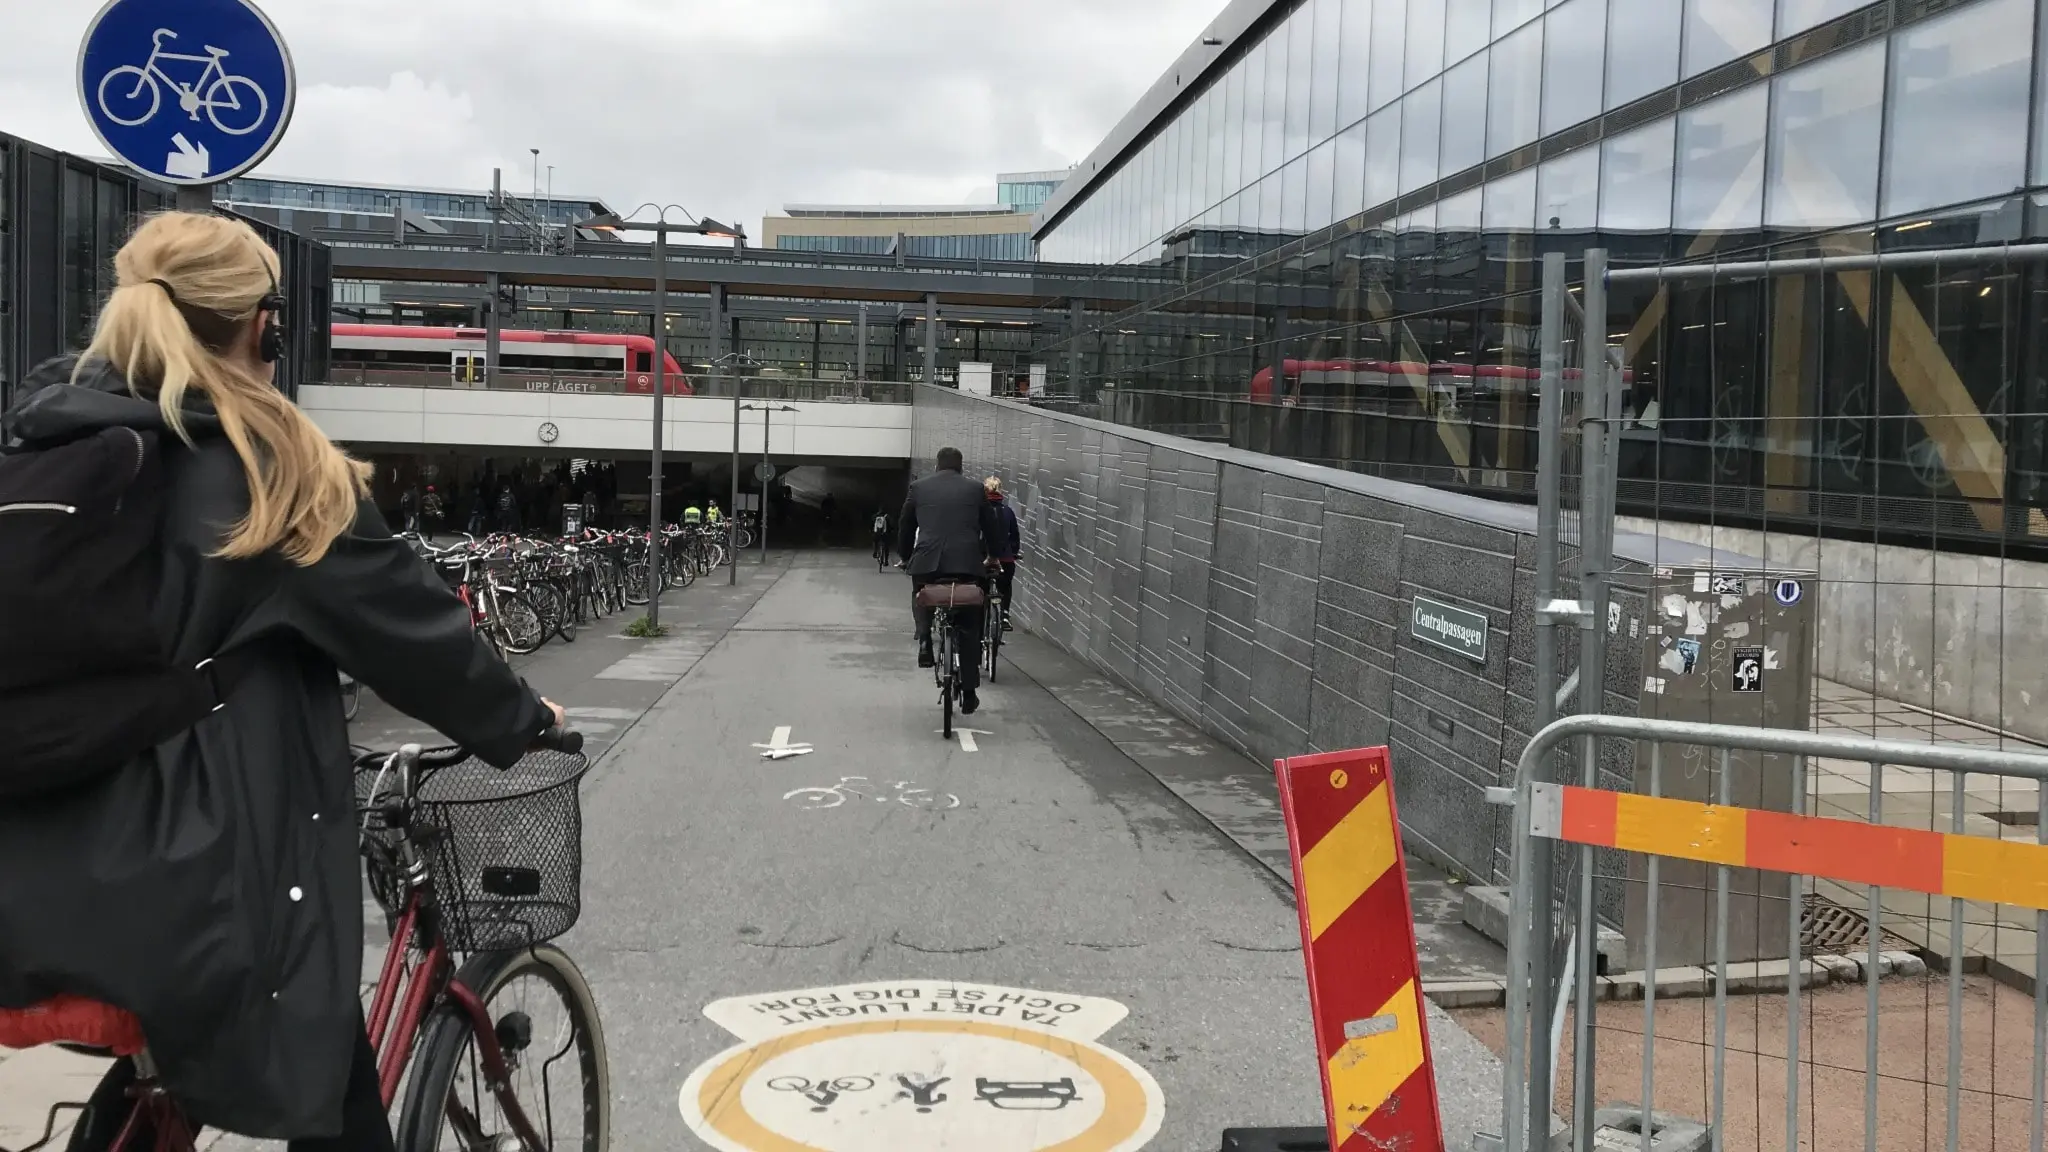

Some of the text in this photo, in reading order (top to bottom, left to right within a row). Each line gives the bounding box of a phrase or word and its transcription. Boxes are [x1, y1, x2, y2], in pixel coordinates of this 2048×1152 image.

[1415, 606, 1482, 648] Centralpassagen
[1369, 763, 1378, 775] H
[749, 988, 1081, 1013] OCH SE DIG FÖR!
[778, 1001, 1061, 1026] TA DET LUGNT
